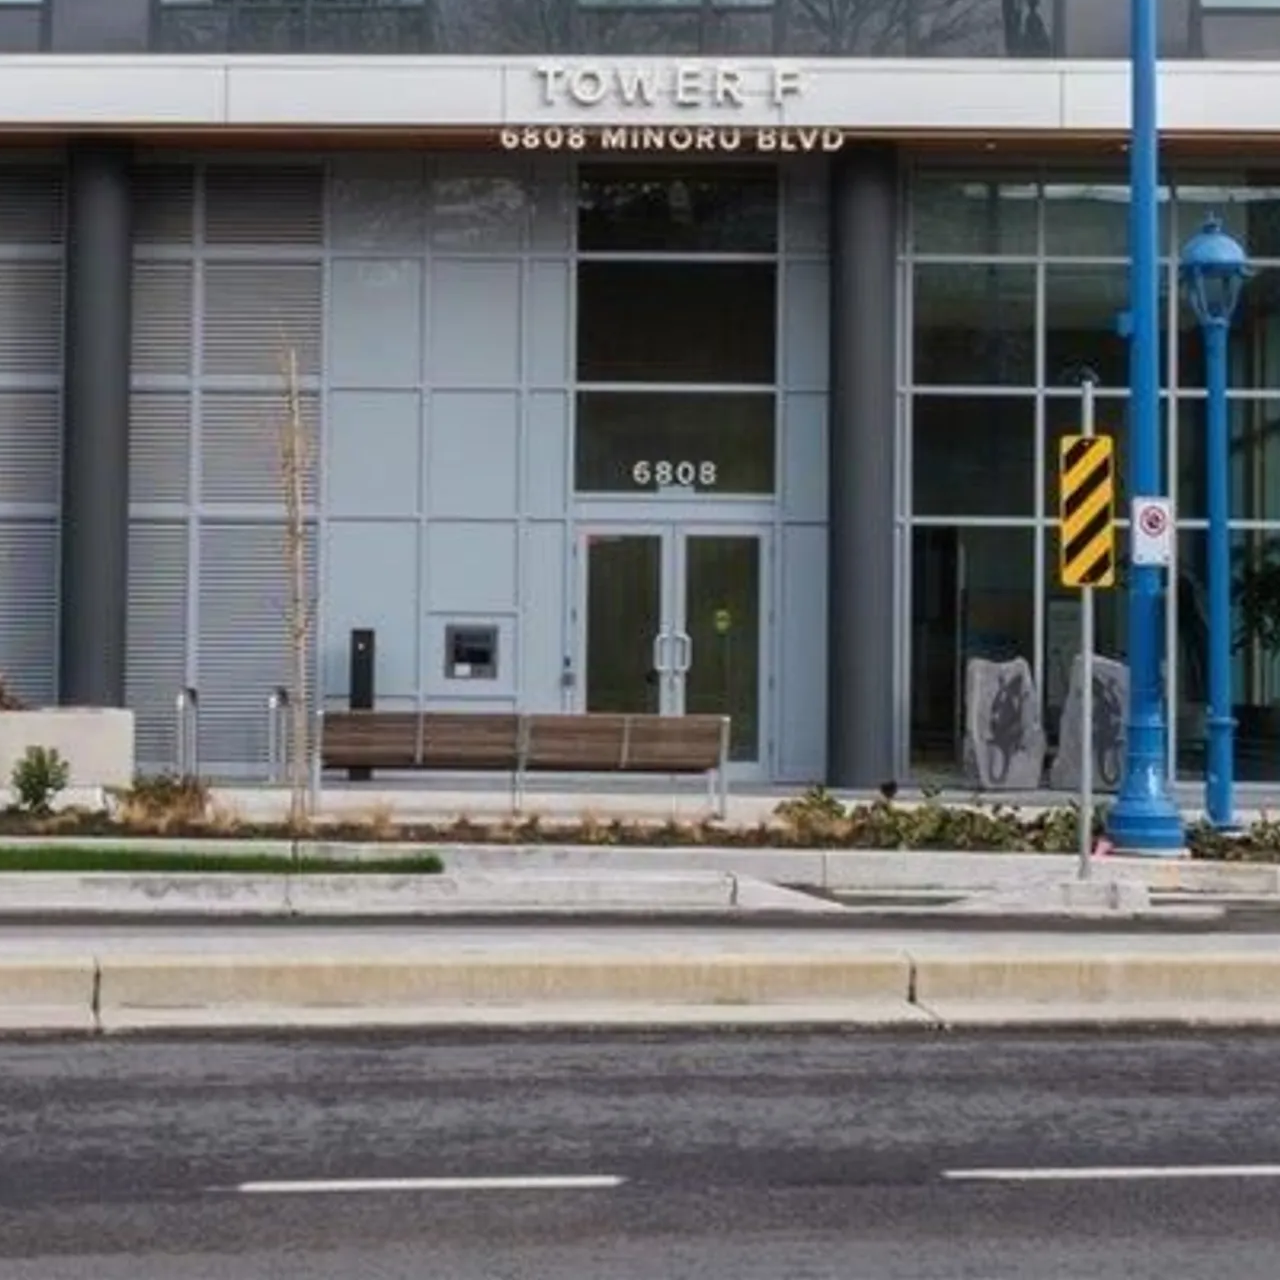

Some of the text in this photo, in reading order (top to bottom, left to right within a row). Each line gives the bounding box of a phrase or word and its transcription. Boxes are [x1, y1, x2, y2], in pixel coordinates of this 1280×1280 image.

[535, 63, 803, 108] TOWER F
[500, 125, 845, 150] 6808 MINORU BLVD
[632, 460, 717, 485] 6808
